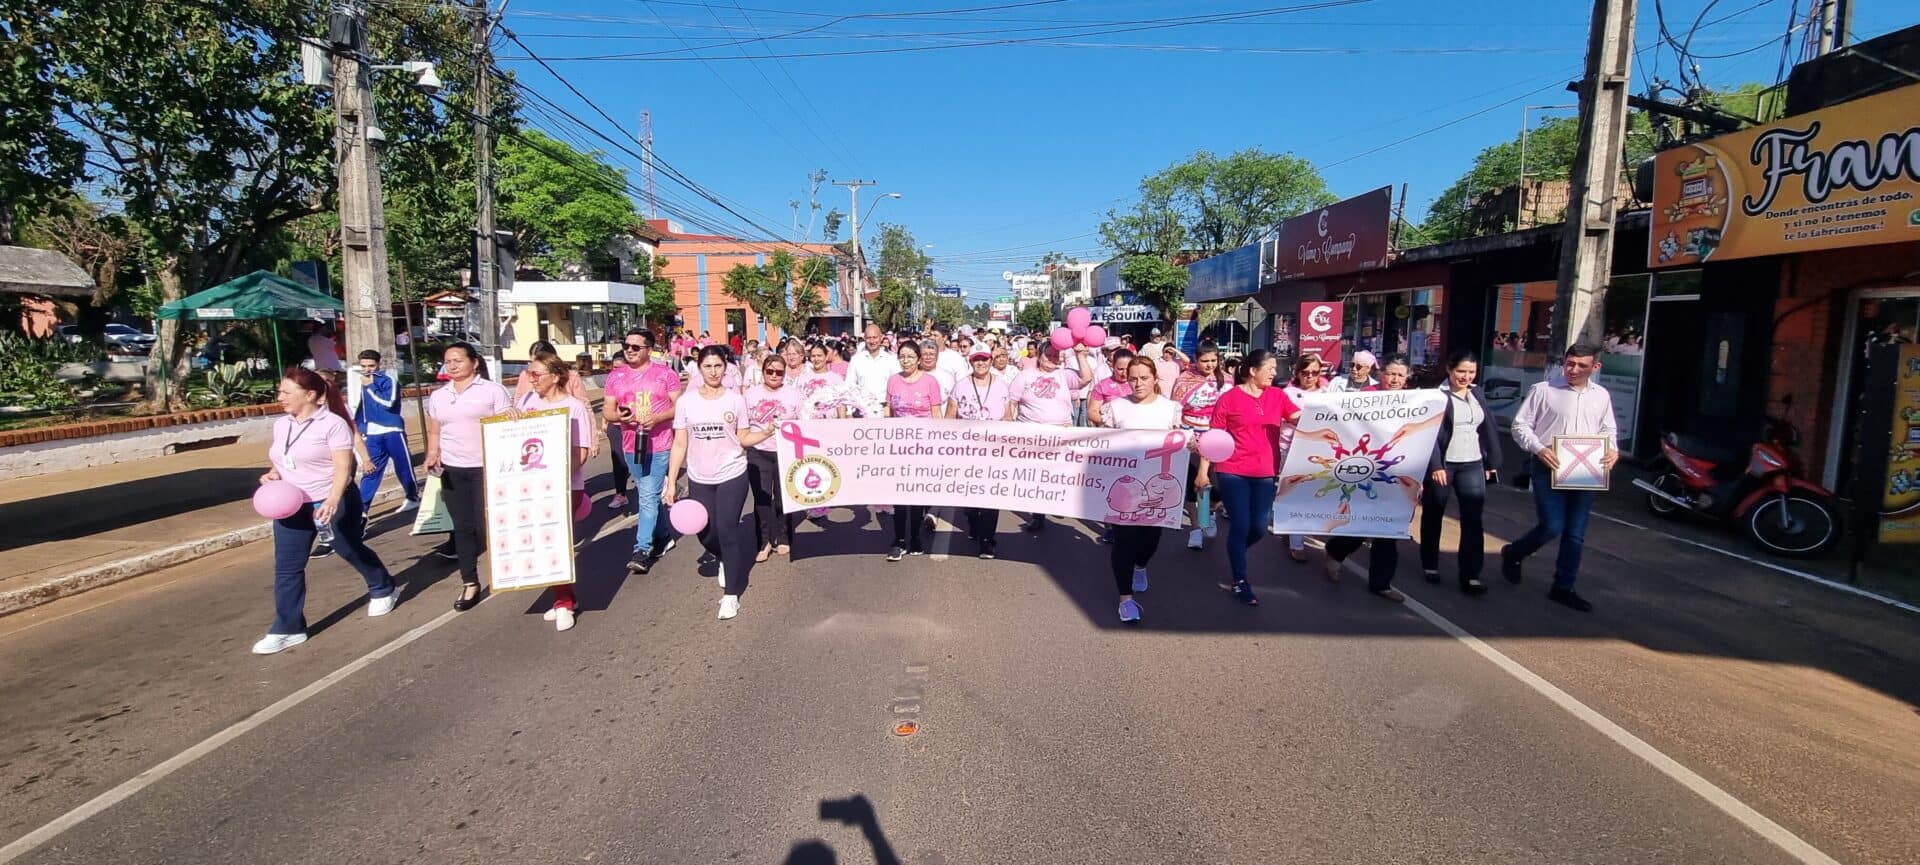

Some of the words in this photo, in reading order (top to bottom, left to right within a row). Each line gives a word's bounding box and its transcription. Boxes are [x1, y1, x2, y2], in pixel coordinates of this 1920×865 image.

[1765, 208, 1799, 219] Donde
[1862, 196, 1876, 205] de
[1784, 222, 1790, 230] y
[1805, 218, 1818, 226] no
[1822, 214, 1832, 223] lo
[1835, 208, 1887, 221] tenemos
[1784, 233, 1794, 241] te
[1797, 230, 1807, 239] lo
[1102, 312, 1153, 320] ESQUINA
[1341, 393, 1408, 409] HOSPITAL
[1314, 411, 1339, 421] DÍA
[1342, 406, 1429, 422] ONCOLÓGICO
[853, 428, 923, 440] OCTUBRE
[928, 429, 958, 441] mes
[962, 428, 980, 441] de
[985, 430, 996, 442] la
[1001, 432, 1110, 448] sensibilización
[827, 443, 868, 456] sobre
[873, 443, 885, 455] la
[890, 443, 933, 456] Lucha
[938, 445, 987, 457] contra
[992, 446, 1004, 458] el
[1009, 446, 1060, 461] Cáncer
[1065, 450, 1083, 463] de
[1088, 455, 1138, 469] mama
[856, 464, 895, 479] ¡Para
[900, 464, 911, 477] ti
[915, 464, 960, 481] mujer
[964, 465, 984, 478] de
[988, 466, 1008, 480] las
[1012, 467, 1035, 482] Mil
[1040, 470, 1106, 491] Batallas,
[896, 481, 941, 493] nunca
[946, 482, 985, 497] dejes
[990, 483, 1009, 496] de
[1013, 484, 1066, 502] luchar!
[1304, 512, 1332, 520] IGNACIO
